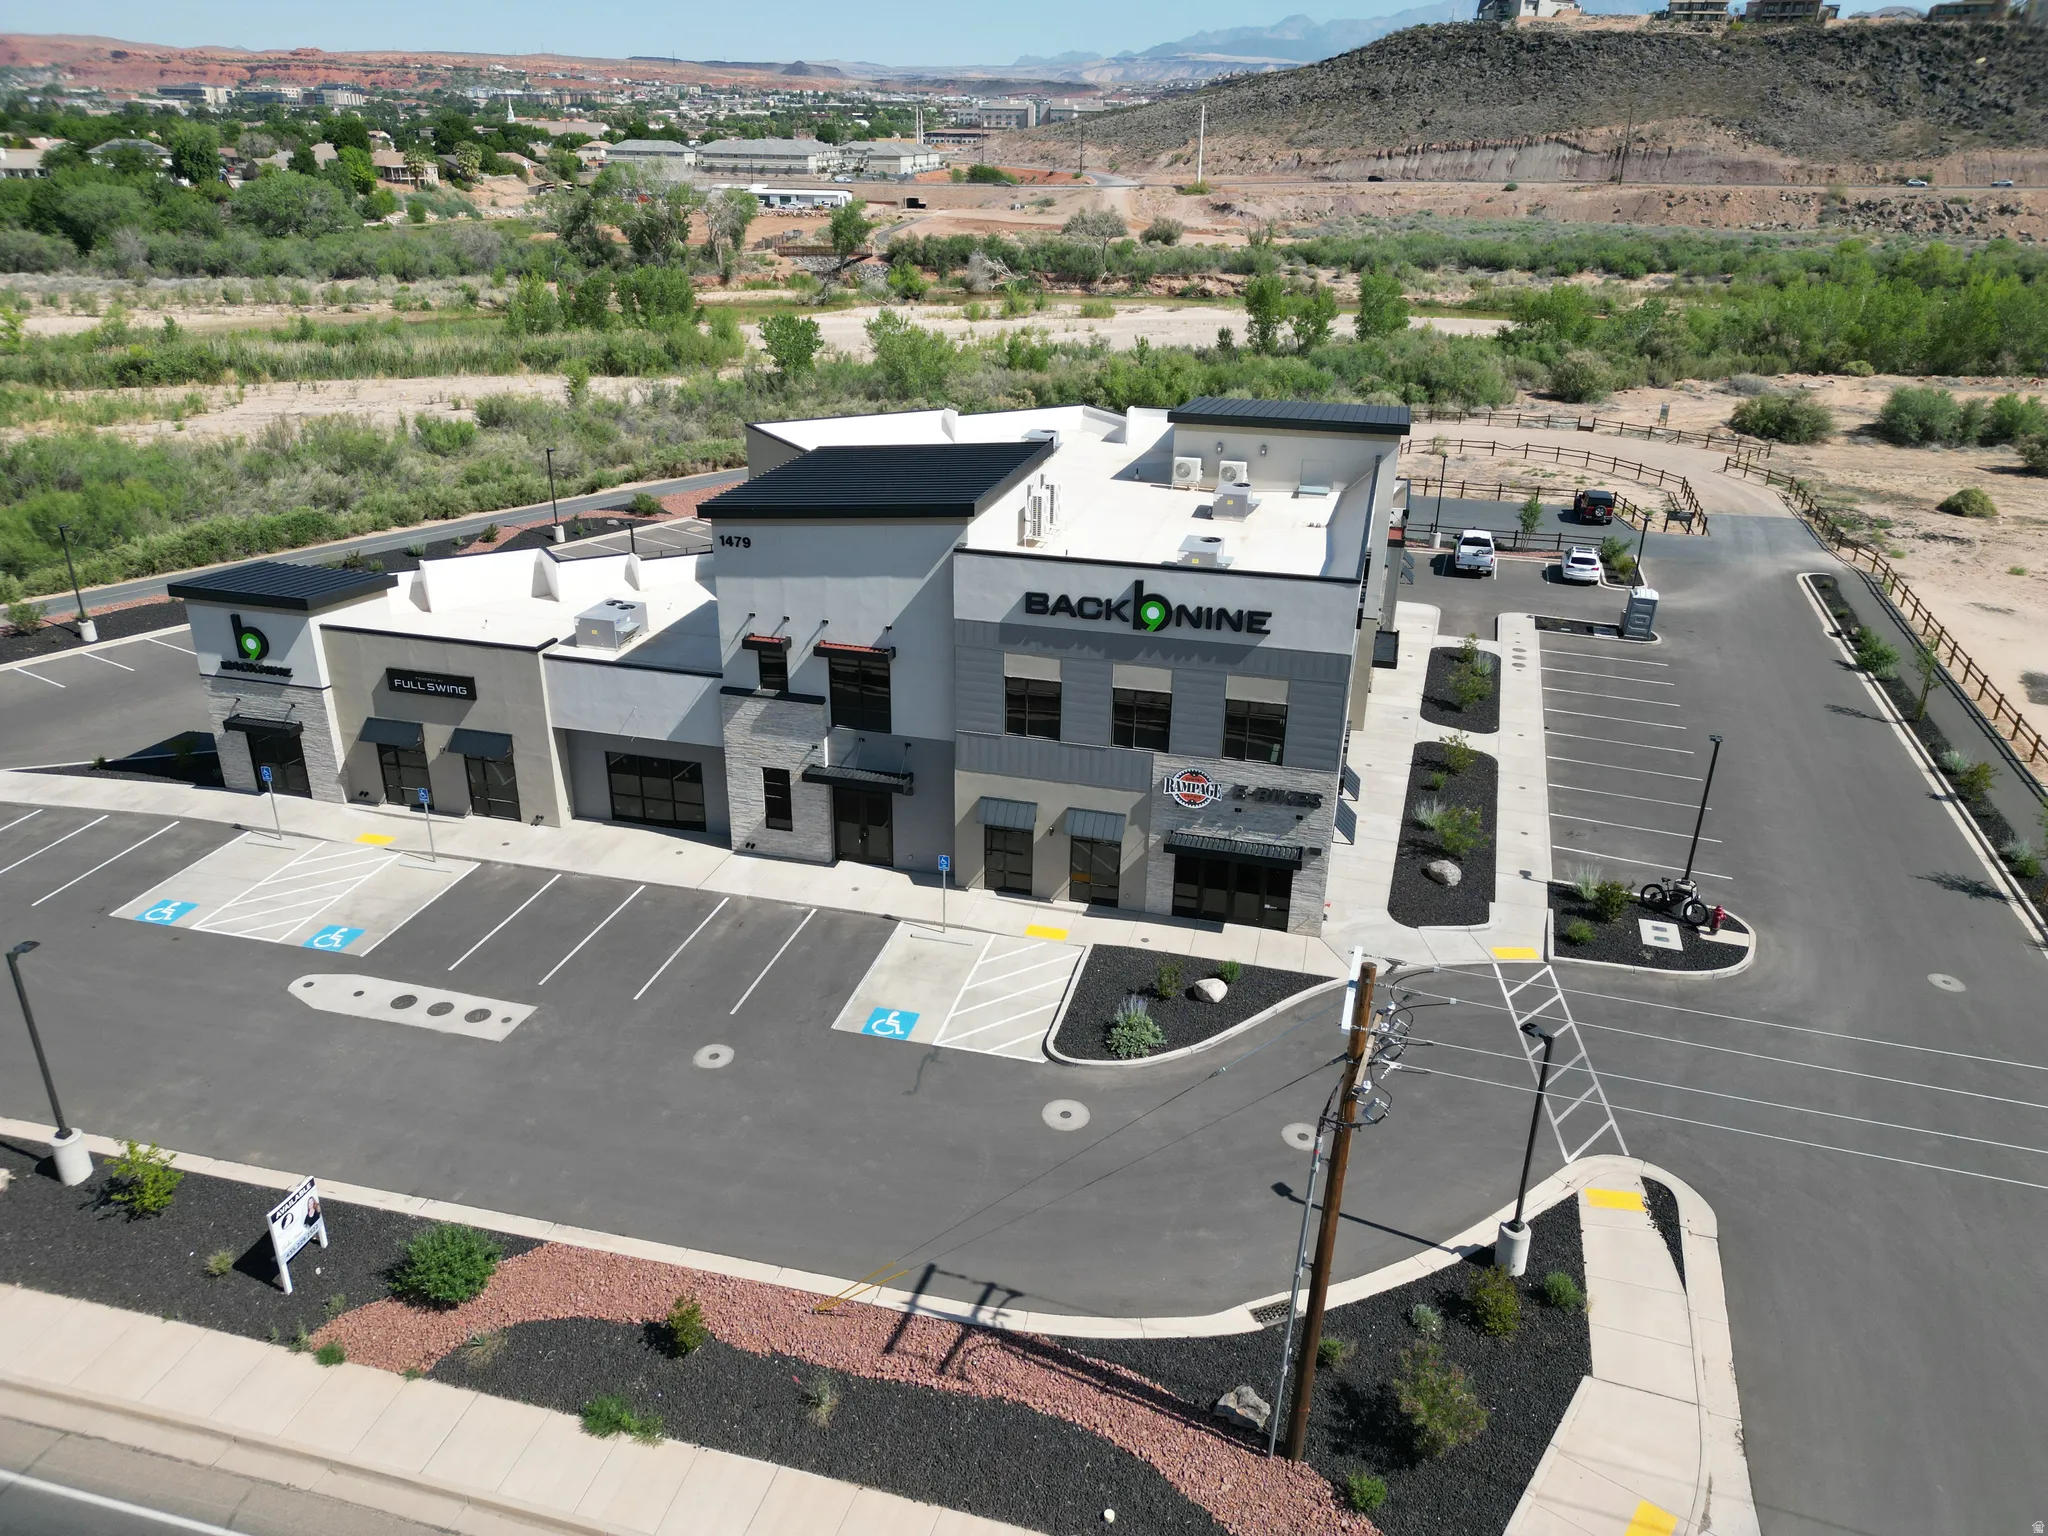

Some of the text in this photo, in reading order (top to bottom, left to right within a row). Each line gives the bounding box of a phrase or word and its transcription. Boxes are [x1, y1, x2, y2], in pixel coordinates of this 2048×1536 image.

[719, 535, 751, 549] 1479
[1025, 591, 1130, 623] BACK
[1175, 603, 1273, 635] NINE
[394, 679, 425, 690] FULL
[426, 683, 467, 695] SWING
[1165, 776, 1222, 800] RAMPAGE
[1232, 784, 1324, 809] E-BIKES
[275, 1182, 312, 1220] AVAILABLE
